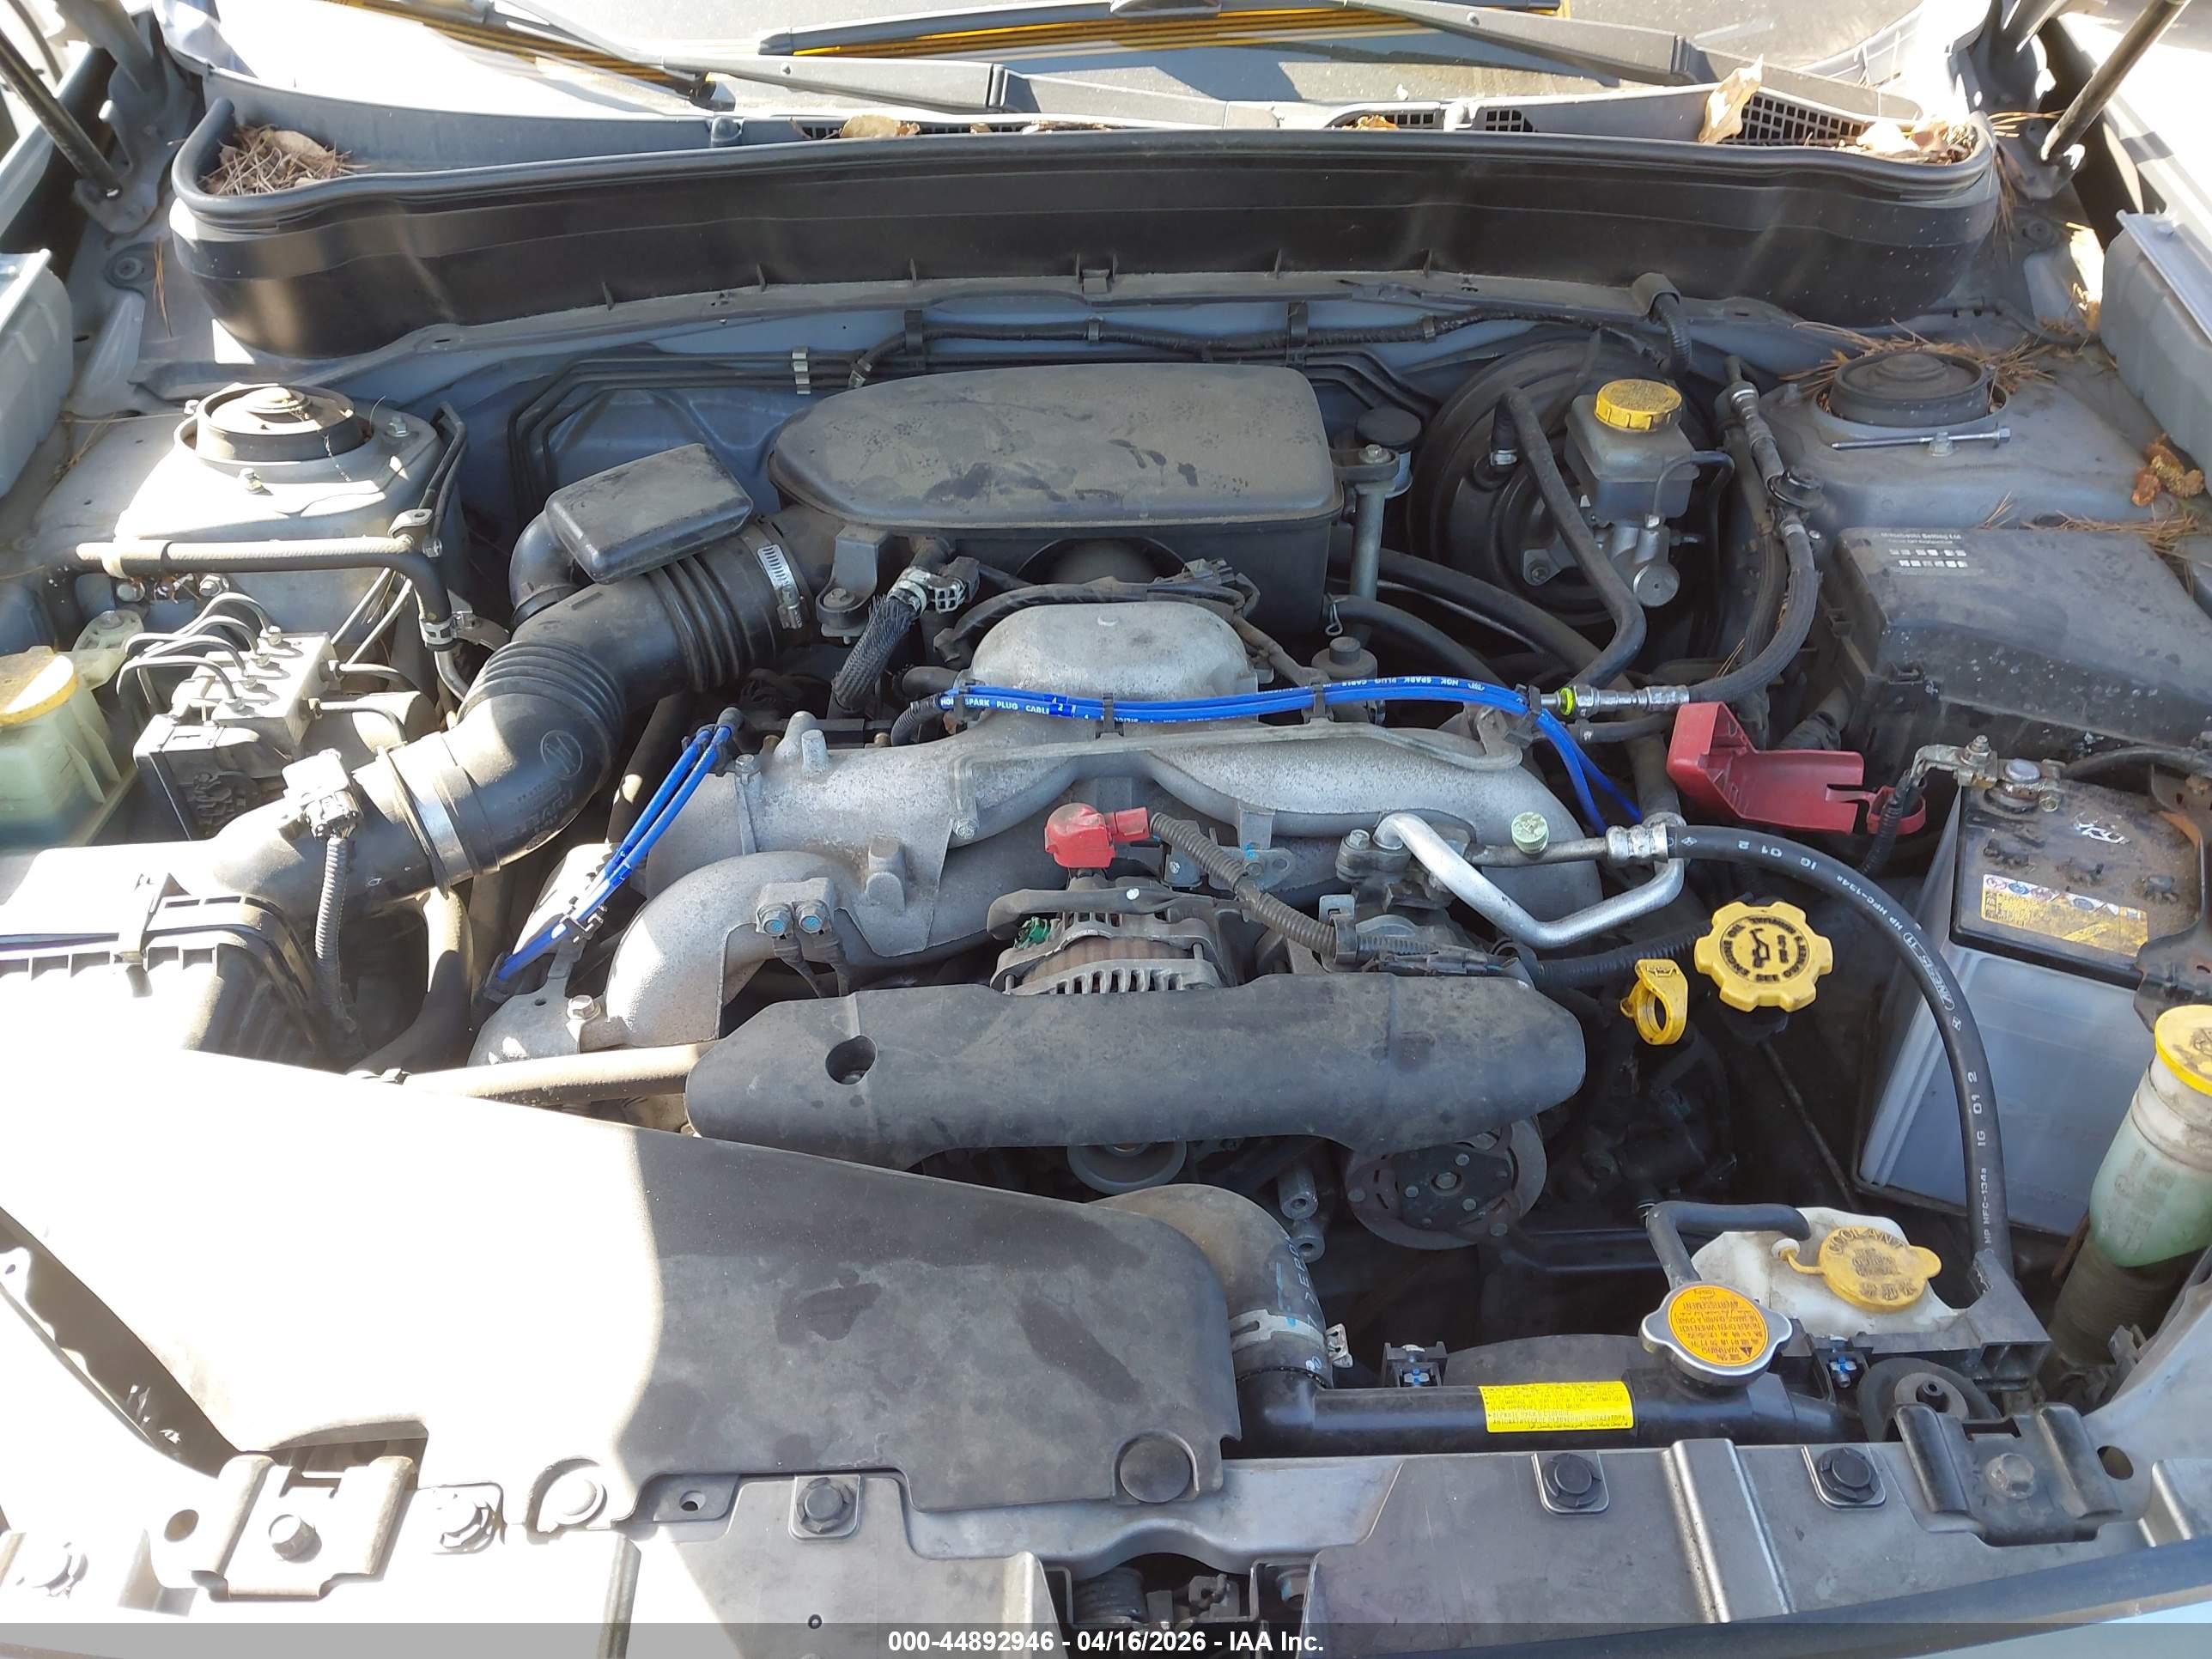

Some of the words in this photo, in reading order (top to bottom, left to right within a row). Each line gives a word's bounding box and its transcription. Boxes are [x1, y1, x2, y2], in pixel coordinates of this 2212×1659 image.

[1440, 678, 1459, 686] NGK
[965, 697, 990, 707] SPARK
[996, 701, 1018, 710] PLUG
[1738, 840, 1750, 850] 2
[1727, 924, 1747, 938] OIL
[1723, 939, 1750, 976] ENGINE
[1755, 974, 1780, 982] SEE
[1968, 1071, 1978, 1084] 2
[1981, 1167, 1990, 1224] HFC-134a
[1826, 1227, 1905, 1255] COOLANT
[1984, 1228, 1992, 1243] HP
